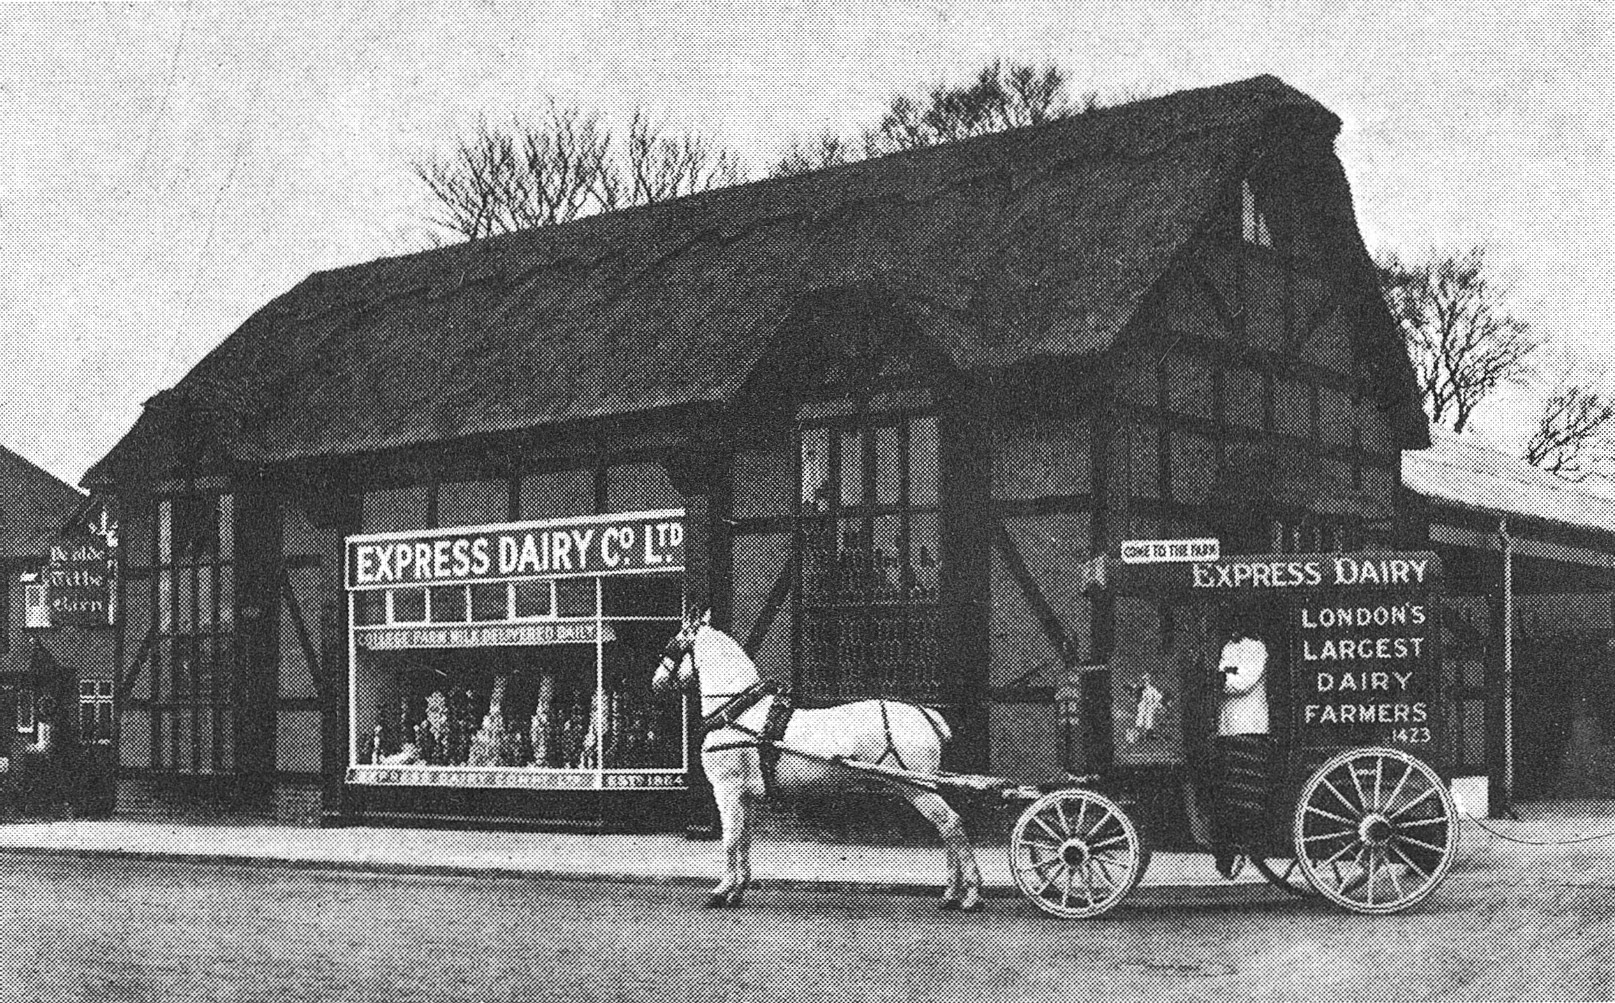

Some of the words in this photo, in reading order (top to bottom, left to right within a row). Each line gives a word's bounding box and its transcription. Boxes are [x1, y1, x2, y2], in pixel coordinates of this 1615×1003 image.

[357, 537, 490, 584] EXPRESS
[500, 528, 596, 574] DAIRY
[1153, 544, 1166, 557] TO
[1169, 544, 1188, 557] THE
[1193, 562, 1321, 588] EXPRESS
[1333, 557, 1428, 586] DAIRY
[1302, 602, 1426, 628] LONDON'S
[557, 625, 595, 640] DAILY
[1303, 638, 1424, 661] LARGEST
[1317, 671, 1413, 692] DAIRY
[1305, 702, 1427, 724] FARMERS
[1392, 727, 1431, 743] 1423
